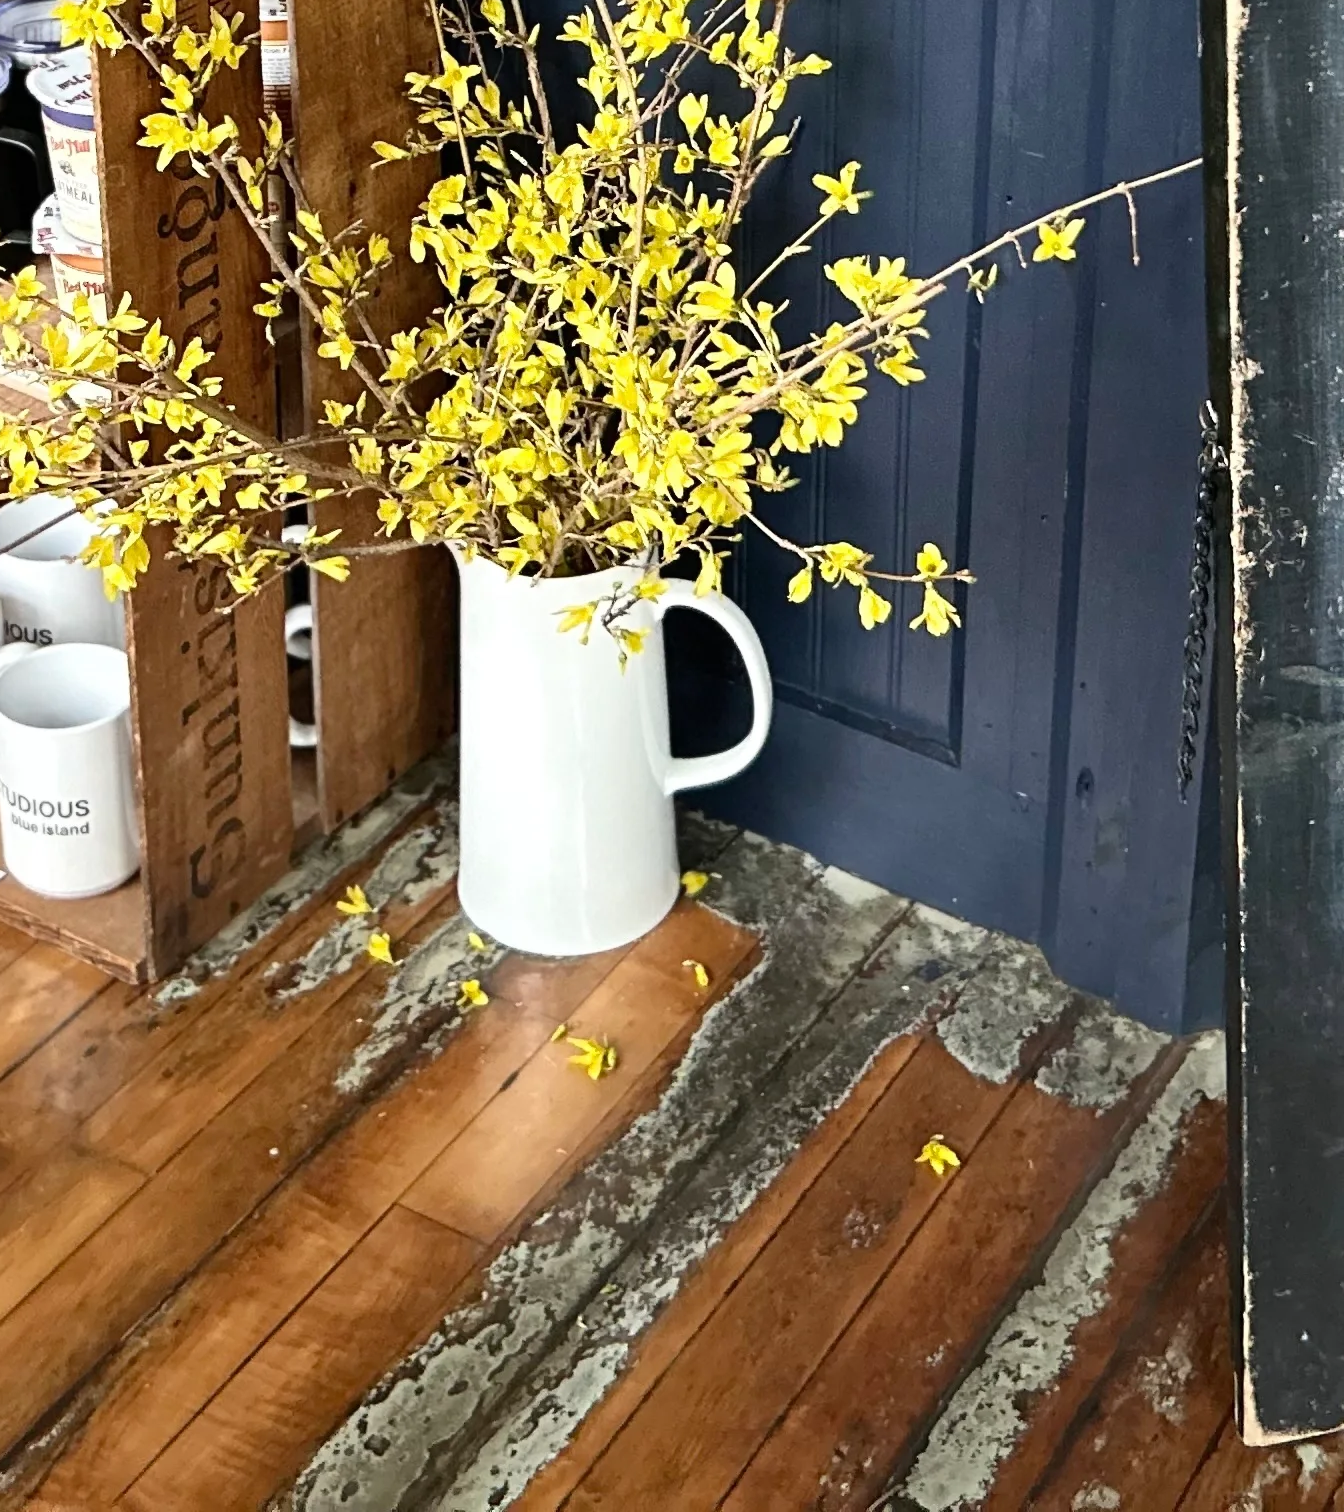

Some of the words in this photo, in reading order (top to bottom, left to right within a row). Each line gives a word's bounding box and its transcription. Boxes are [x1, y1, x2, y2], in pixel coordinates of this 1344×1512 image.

[4, 619, 54, 646] IOUS
[0, 778, 91, 820] TUDIOUS
[11, 812, 39, 835] blue
[42, 821, 91, 837] island
